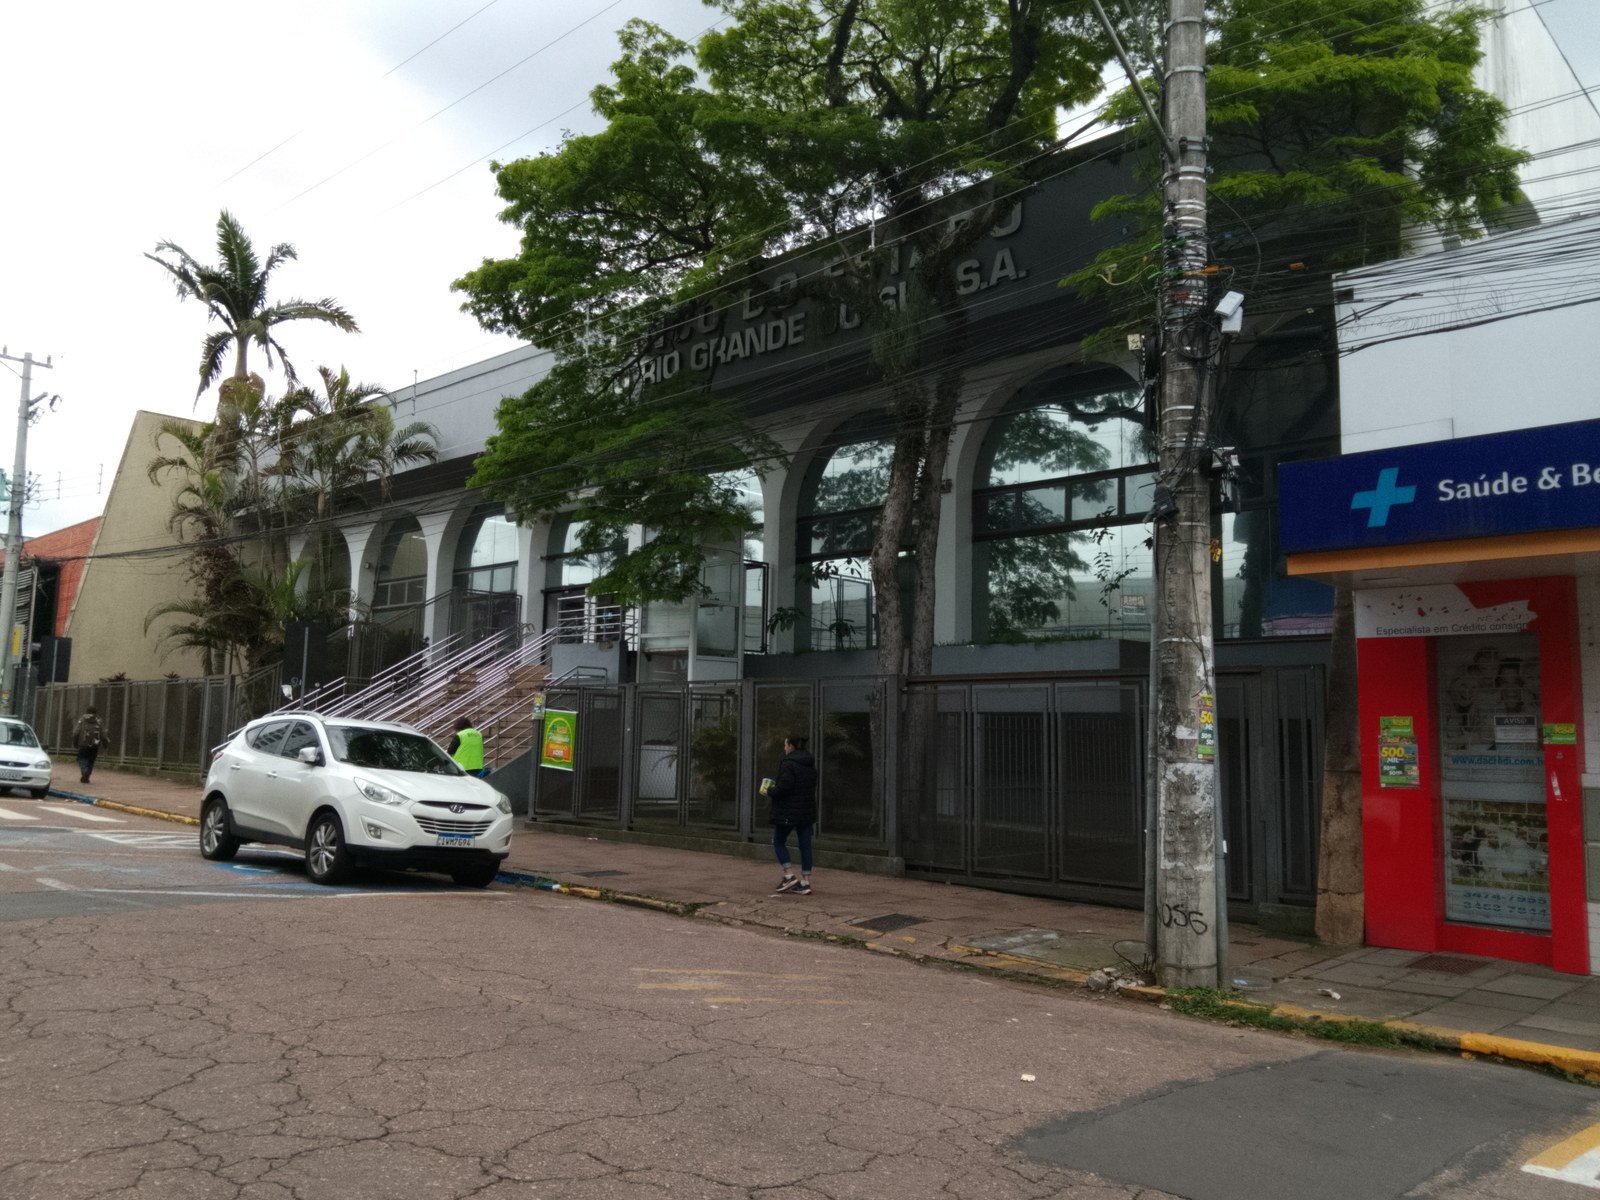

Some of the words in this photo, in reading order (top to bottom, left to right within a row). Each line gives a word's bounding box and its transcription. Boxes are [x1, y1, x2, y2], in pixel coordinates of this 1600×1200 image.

[690, 312, 806, 372] GRANDE
[956, 246, 1028, 296] S.A.
[1438, 473, 1529, 502] Saúde
[1537, 466, 1562, 491] &
[1376, 625, 1431, 637] Especialista
[1434, 626, 1449, 634] em
[1451, 622, 1487, 633] Crédito
[1381, 747, 1405, 758] 500
